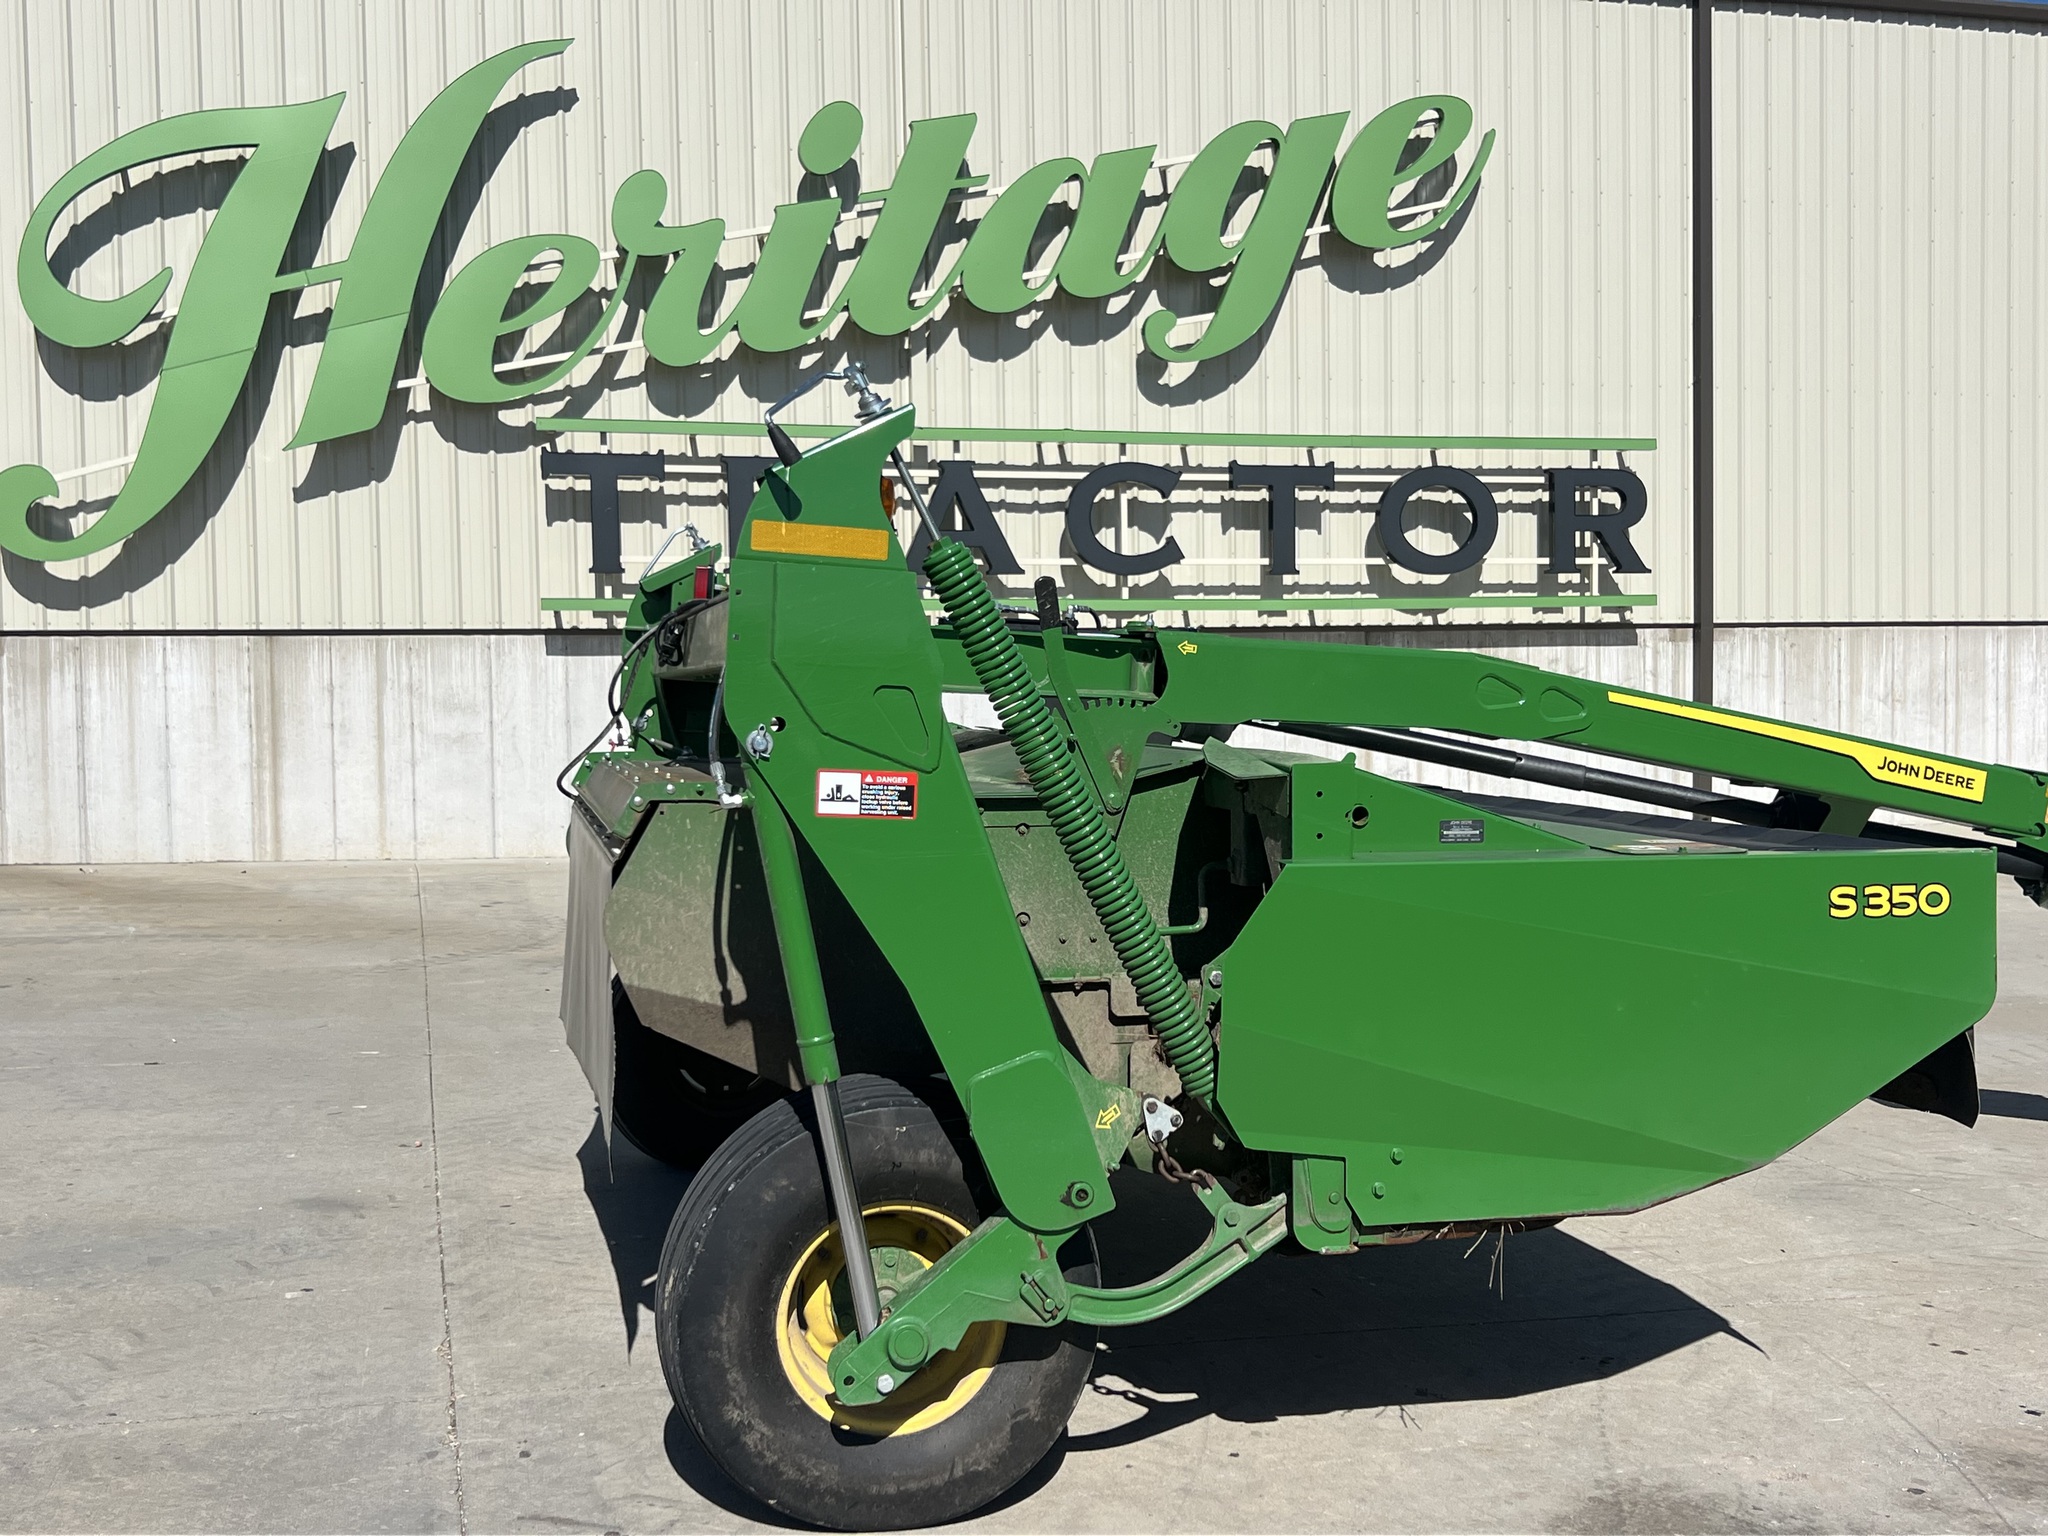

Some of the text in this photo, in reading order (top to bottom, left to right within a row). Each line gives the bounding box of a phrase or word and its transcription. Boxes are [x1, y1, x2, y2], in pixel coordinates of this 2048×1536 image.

[0, 38, 1496, 562] Heritage
[876, 776, 908, 784] DANGER
[1877, 756, 1976, 790] JOHN DEERE
